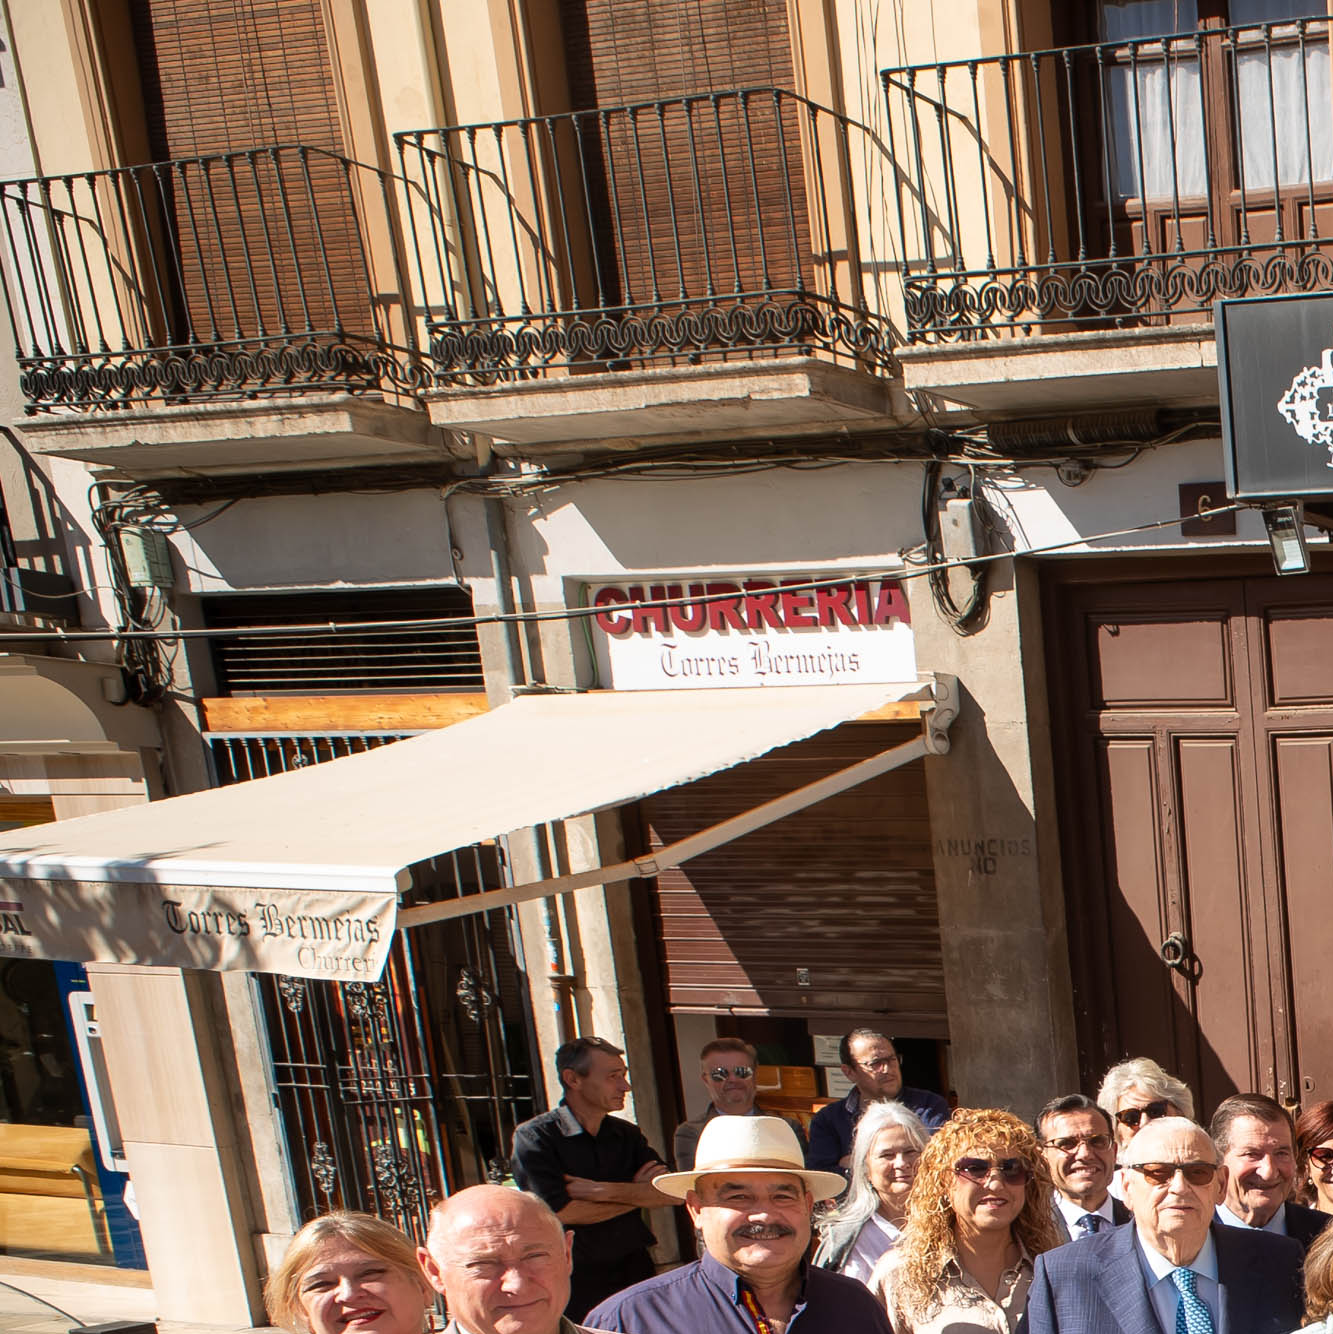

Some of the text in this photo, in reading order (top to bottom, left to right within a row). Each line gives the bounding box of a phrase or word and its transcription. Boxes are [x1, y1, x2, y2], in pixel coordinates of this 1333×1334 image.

[1198, 494, 1213, 522] 6
[595, 576, 912, 634] CHURRERIA
[660, 640, 861, 679] Torres Bermejas
[161, 900, 381, 944] Torres Bermejas
